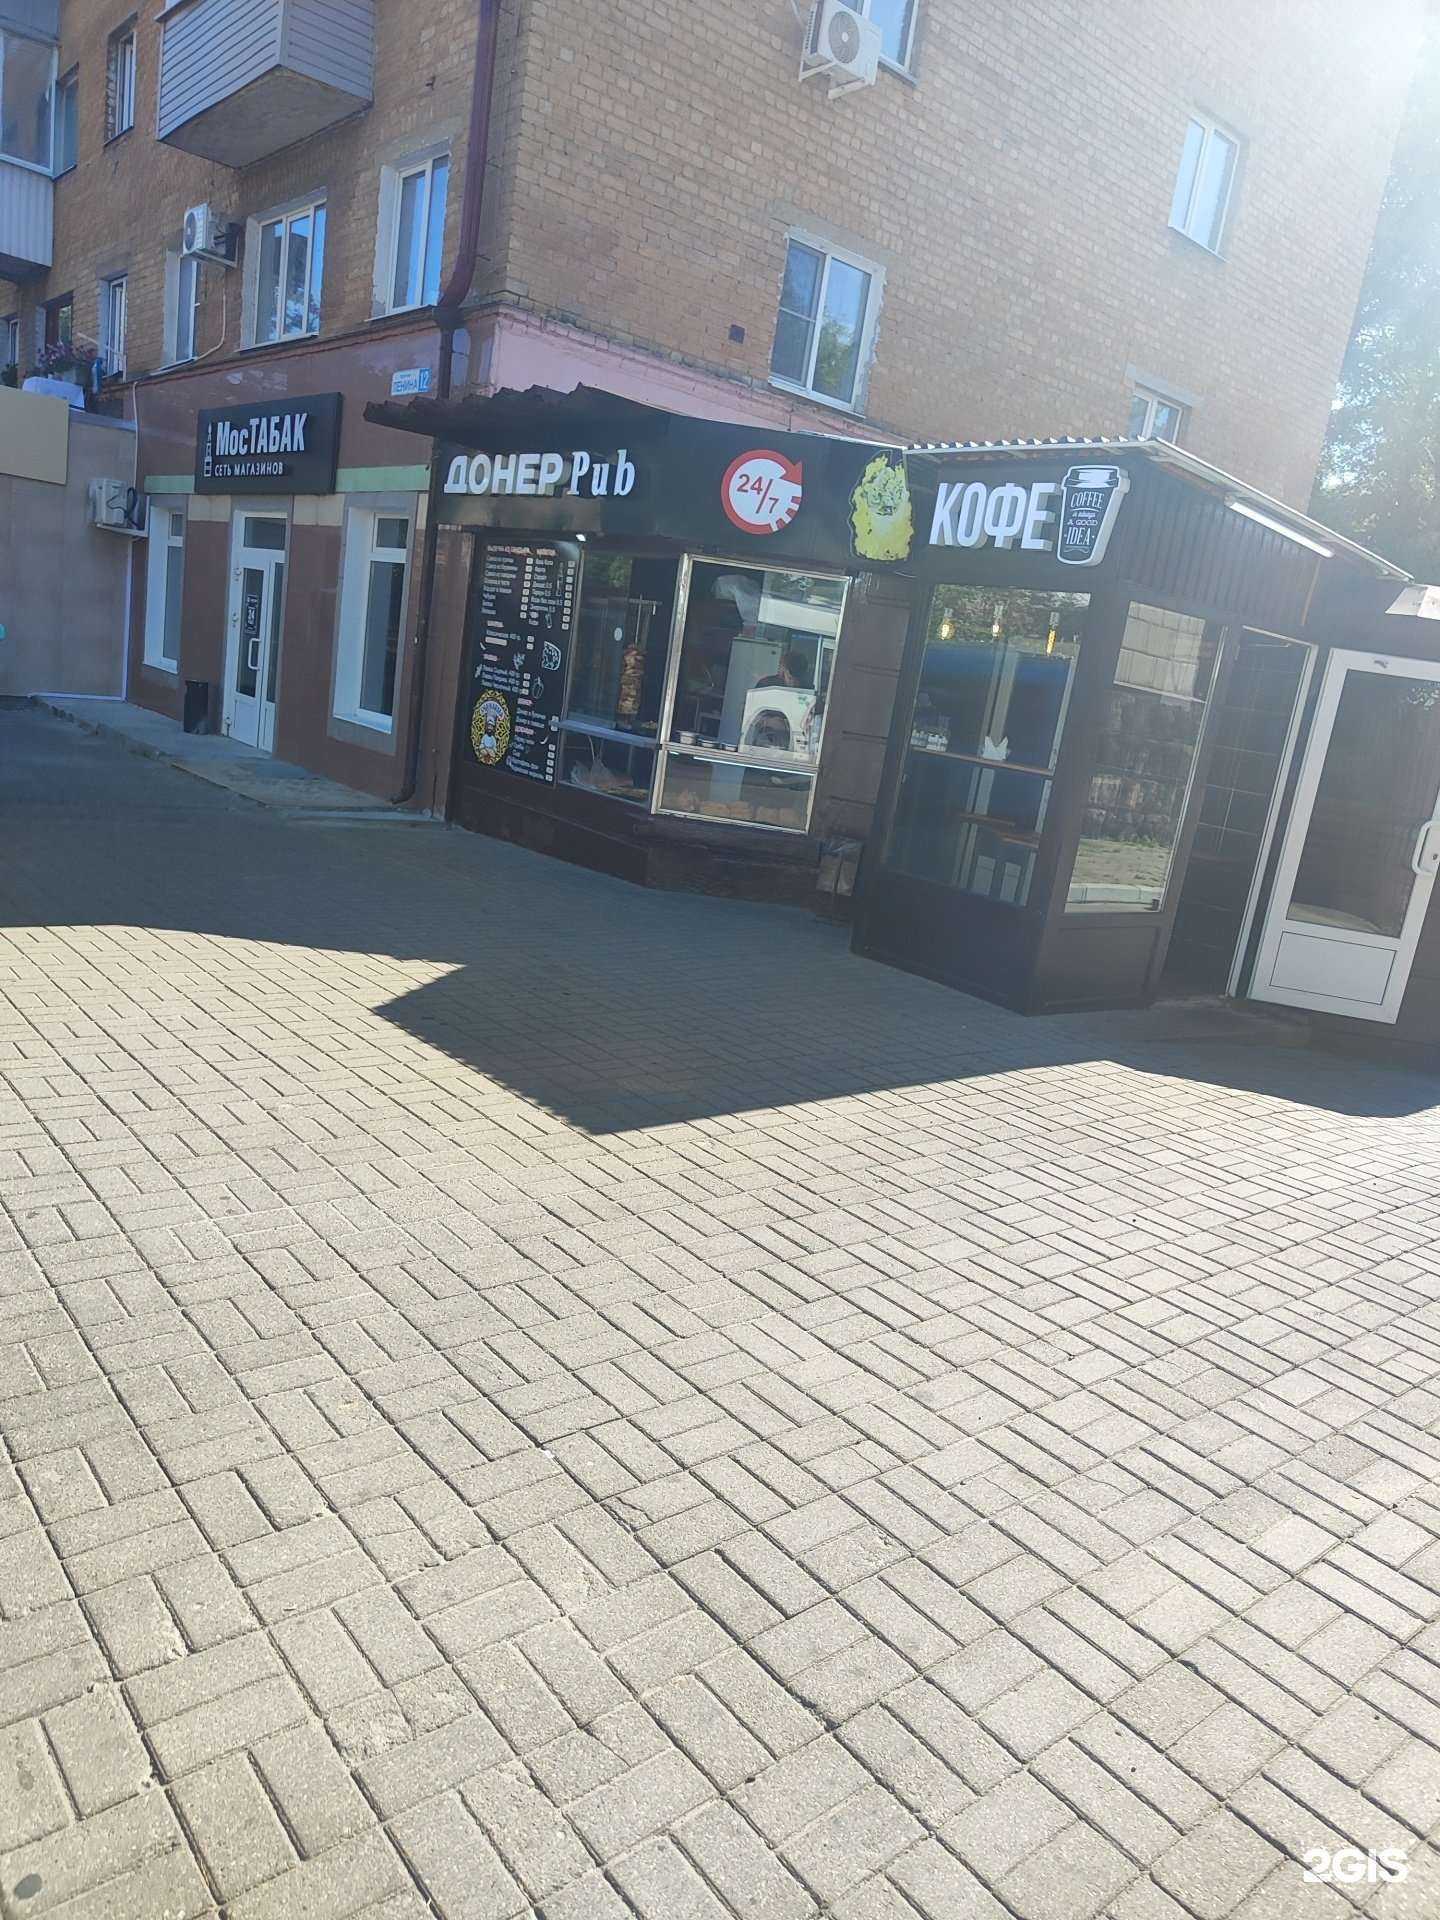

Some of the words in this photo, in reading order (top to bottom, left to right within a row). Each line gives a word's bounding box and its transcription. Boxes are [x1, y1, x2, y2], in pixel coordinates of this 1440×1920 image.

[420, 369, 431, 390] 12
[215, 413, 308, 456] МосТАБАК
[214, 463, 232, 477] СЕТЬ
[233, 461, 284, 476] МАГАЗИНОВ
[444, 452, 565, 496] ДОНЕР
[566, 448, 636, 497] Pub
[736, 472, 781, 515] 24/7
[1070, 490, 1105, 509] COFFEE
[928, 481, 1058, 551] КОФЕ
[1065, 526, 1091, 546] IDEA
